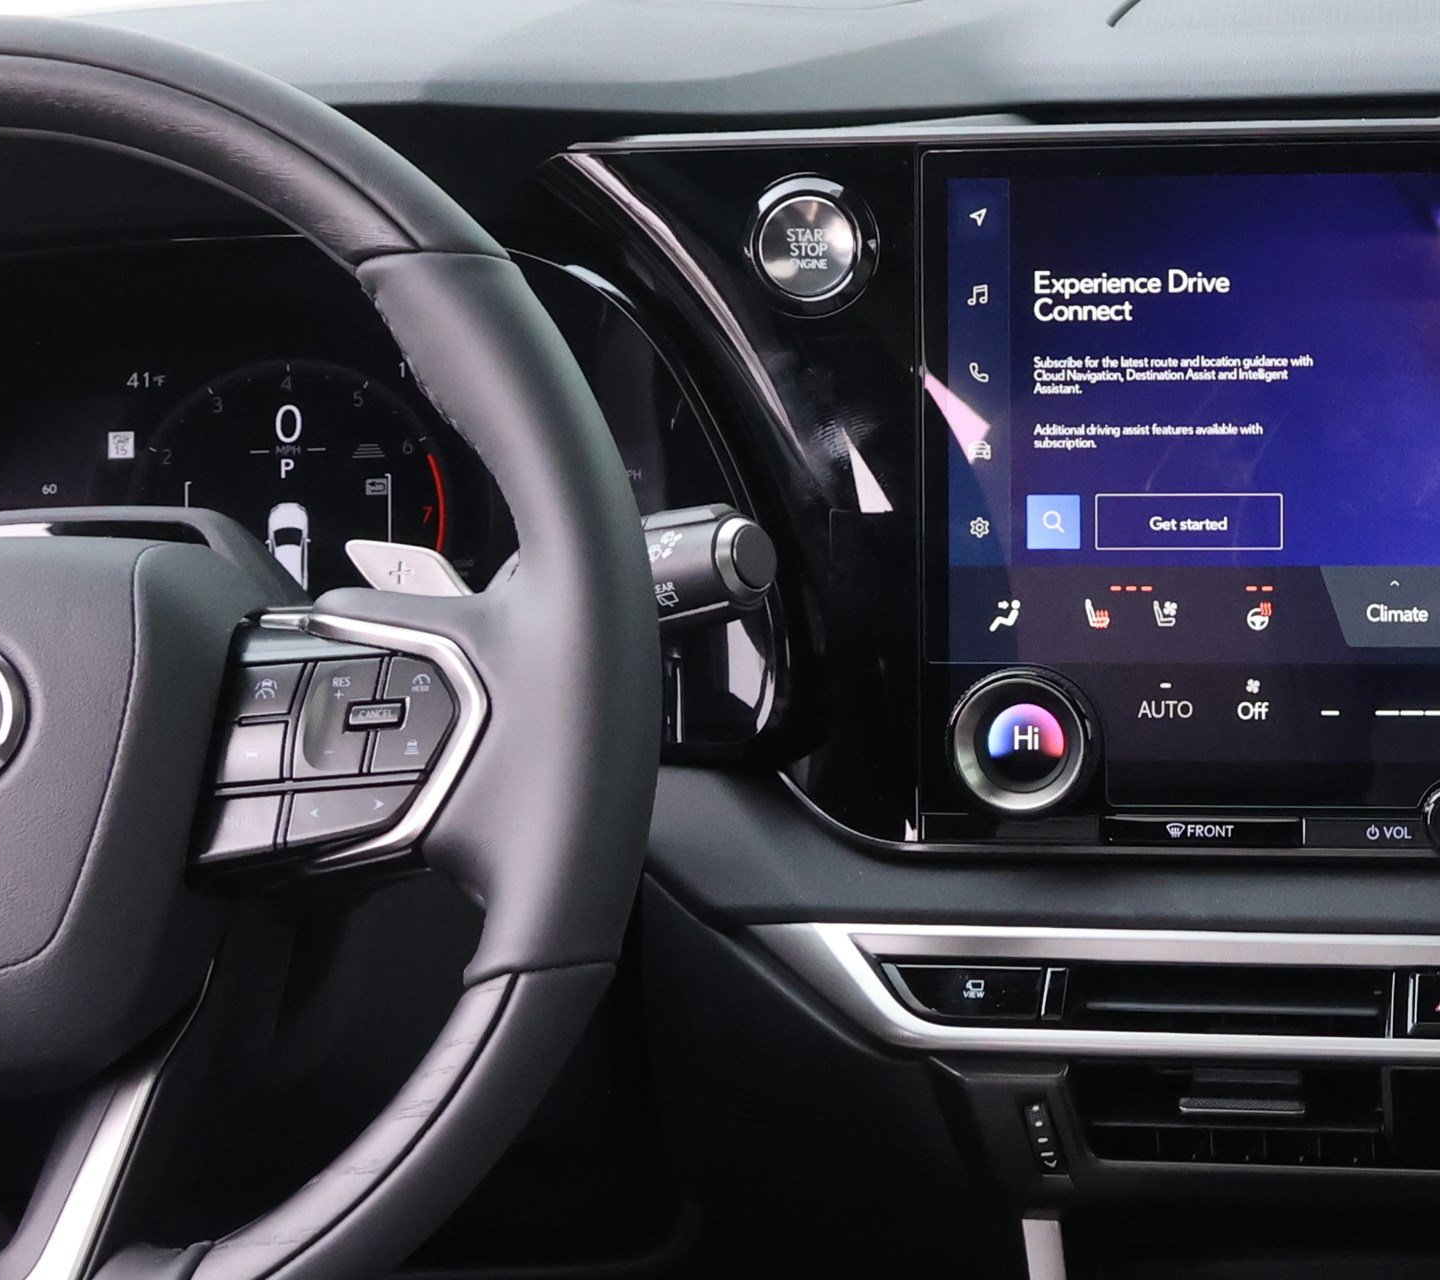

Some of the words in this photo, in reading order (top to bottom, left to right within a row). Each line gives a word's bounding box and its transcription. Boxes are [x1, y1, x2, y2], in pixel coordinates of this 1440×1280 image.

[786, 228, 828, 242] STAR
[789, 242, 828, 257] STOP
[790, 258, 828, 269] ENGINE
[1034, 270, 1162, 299] Experience
[1167, 268, 1231, 294] Drive
[1033, 297, 1134, 322] Connect
[1033, 356, 1083, 368] Subscribe
[1084, 356, 1100, 368] for
[1101, 356, 1119, 368] the
[1120, 356, 1149, 368] latest
[1150, 357, 1179, 368] route
[1180, 355, 1200, 367] and
[1201, 355, 1241, 367] location
[1242, 355, 1288, 369] guidance
[1290, 354, 1314, 367] with
[280, 375, 292, 390] 4
[1033, 369, 1065, 381] Cloud
[1066, 369, 1124, 383] Navigation,
[1126, 368, 1184, 381] Destination
[1185, 368, 1216, 380] Assist
[1218, 368, 1237, 380] and
[1238, 368, 1289, 382] Intelligent
[1033, 382, 1083, 394] Assistant.
[213, 397, 223, 413] 3
[353, 391, 363, 408] 5
[274, 404, 302, 444] 0
[1033, 423, 1085, 436] Additional
[1086, 424, 1121, 438] driving
[1122, 424, 1150, 435] assist
[1151, 423, 1194, 435] features
[1195, 423, 1239, 435] available
[1239, 422, 1264, 435] with
[276, 445, 301, 456] MPH
[402, 439, 413, 455] 6
[1033, 437, 1097, 451] subscription.
[162, 449, 172, 466] 2
[280, 459, 295, 479] P
[41, 483, 58, 495] 60
[423, 506, 433, 524] 7
[1148, 516, 1177, 531] Get
[1179, 516, 1228, 531] started
[1366, 603, 1429, 623] Climate
[331, 676, 351, 687] RES
[358, 708, 393, 719] CANCEL
[1137, 700, 1193, 719] AUTO
[1237, 701, 1270, 720] Off
[1013, 725, 1040, 751] Hi
[1187, 825, 1235, 838] FRONT
[1383, 826, 1412, 839] VOL
[962, 990, 985, 998] VIEW
